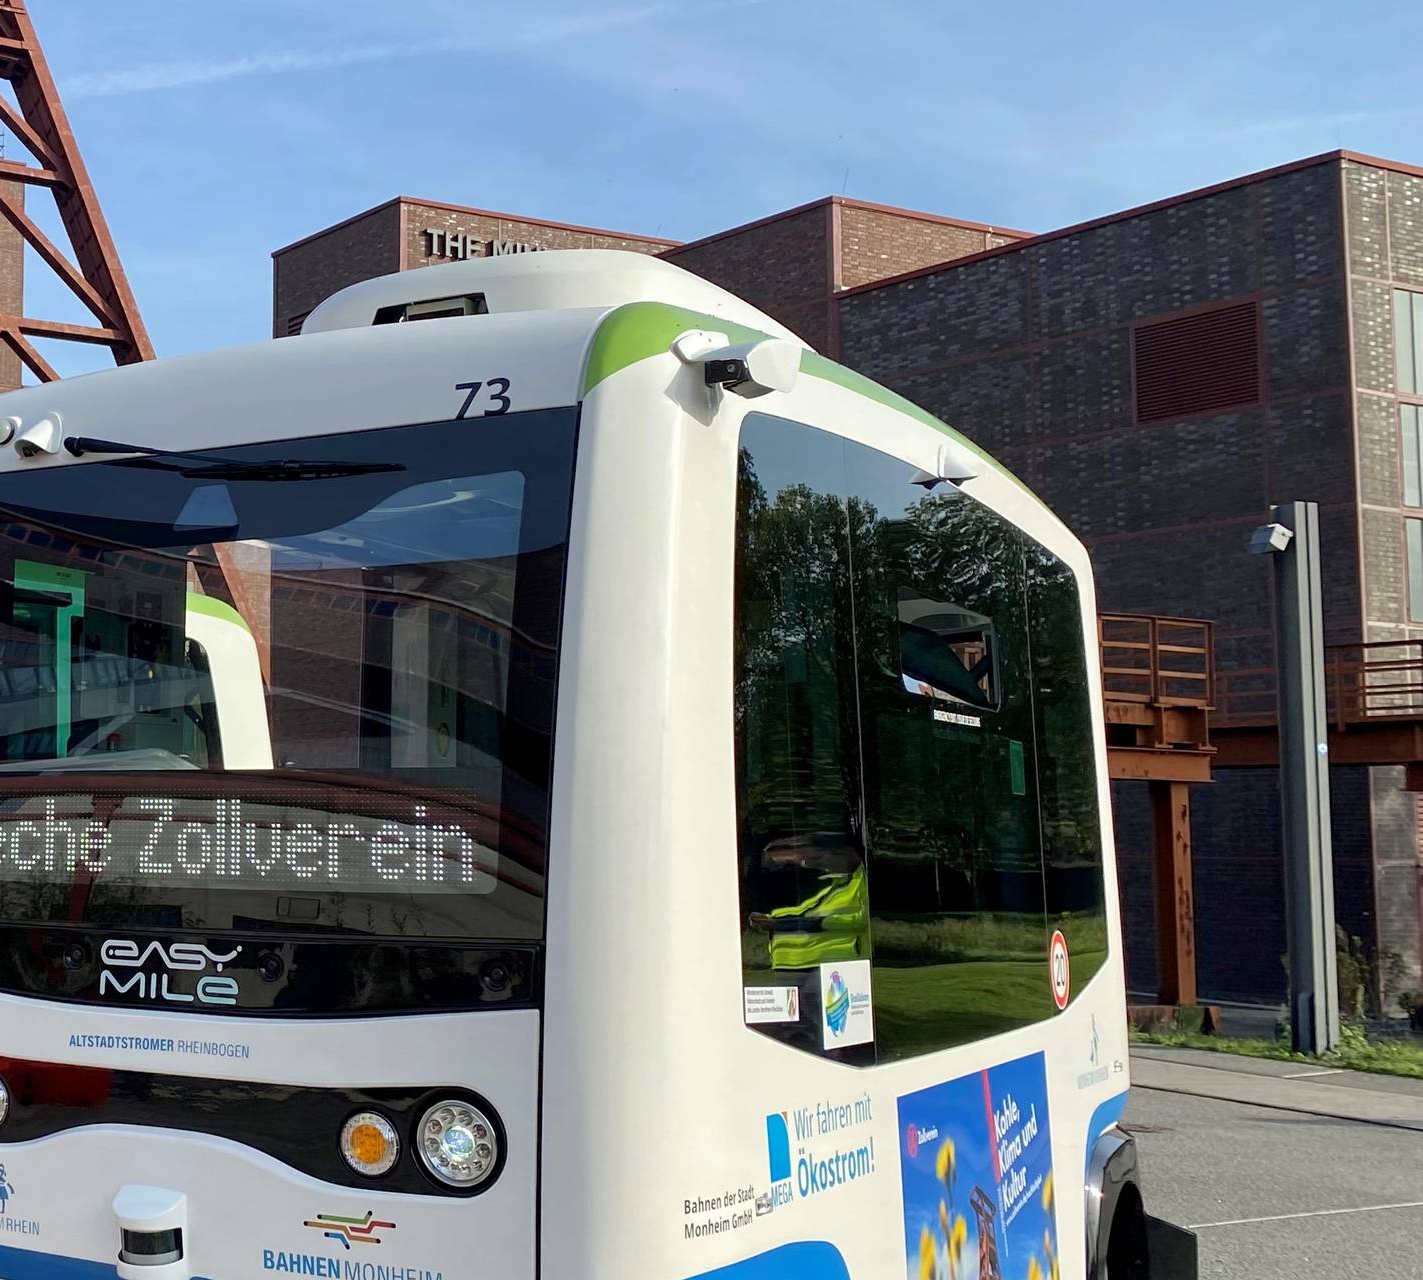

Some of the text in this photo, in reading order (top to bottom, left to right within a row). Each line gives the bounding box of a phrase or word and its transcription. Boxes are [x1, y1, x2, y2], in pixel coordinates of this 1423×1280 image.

[426, 228, 483, 260] THE
[454, 377, 511, 420] 73
[137, 798, 475, 883] Zollverein
[1055, 953, 1066, 987] 20
[69, 1034, 250, 1058] ALTSTADTSTROMER RHEINBOGEN
[794, 1091, 873, 1141] Wir fahren mit
[993, 1093, 1020, 1143] Kohle,
[998, 1134, 1022, 1178] Klima
[1022, 1103, 1038, 1148] und
[797, 1136, 875, 1198] Ökostrom!
[684, 1194, 722, 1215] Bahnen
[724, 1191, 736, 1208] der
[738, 1184, 755, 1204] Stadt
[771, 1181, 794, 1208] MEGA
[1001, 1166, 1027, 1212] Kultur
[6, 1217, 40, 1236] RHEIN
[684, 1209, 753, 1240] Monheim GmbH
[263, 1249, 341, 1280] BAHNEN
